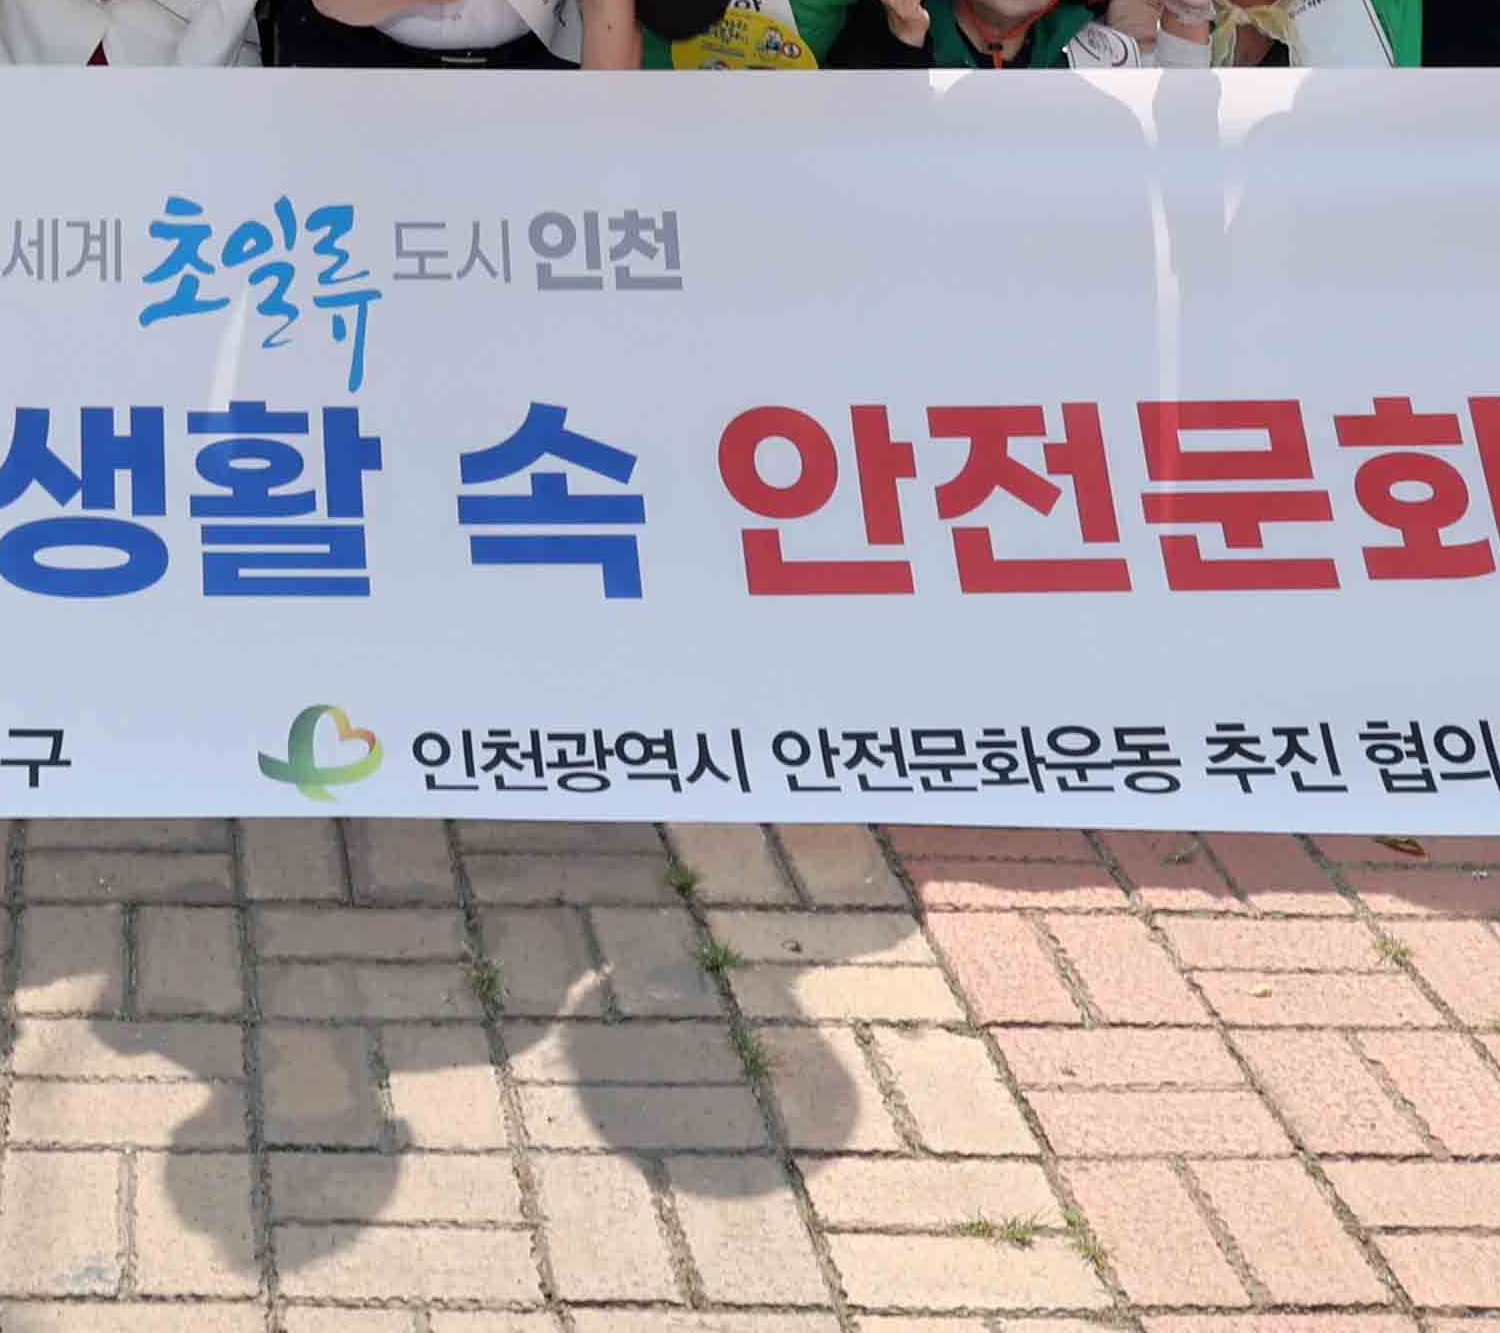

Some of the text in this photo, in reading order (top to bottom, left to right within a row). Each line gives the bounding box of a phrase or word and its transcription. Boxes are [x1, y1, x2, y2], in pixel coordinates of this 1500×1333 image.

[1, 218, 123, 282] 세계
[139, 195, 383, 393] 초일류
[394, 218, 512, 284] 도시
[528, 210, 681, 290] 인천
[456, 401, 647, 599] 속
[411, 727, 751, 794] 인천광역시
[771, 724, 1182, 795] 안전문화운동
[1205, 721, 1349, 794] 추진
